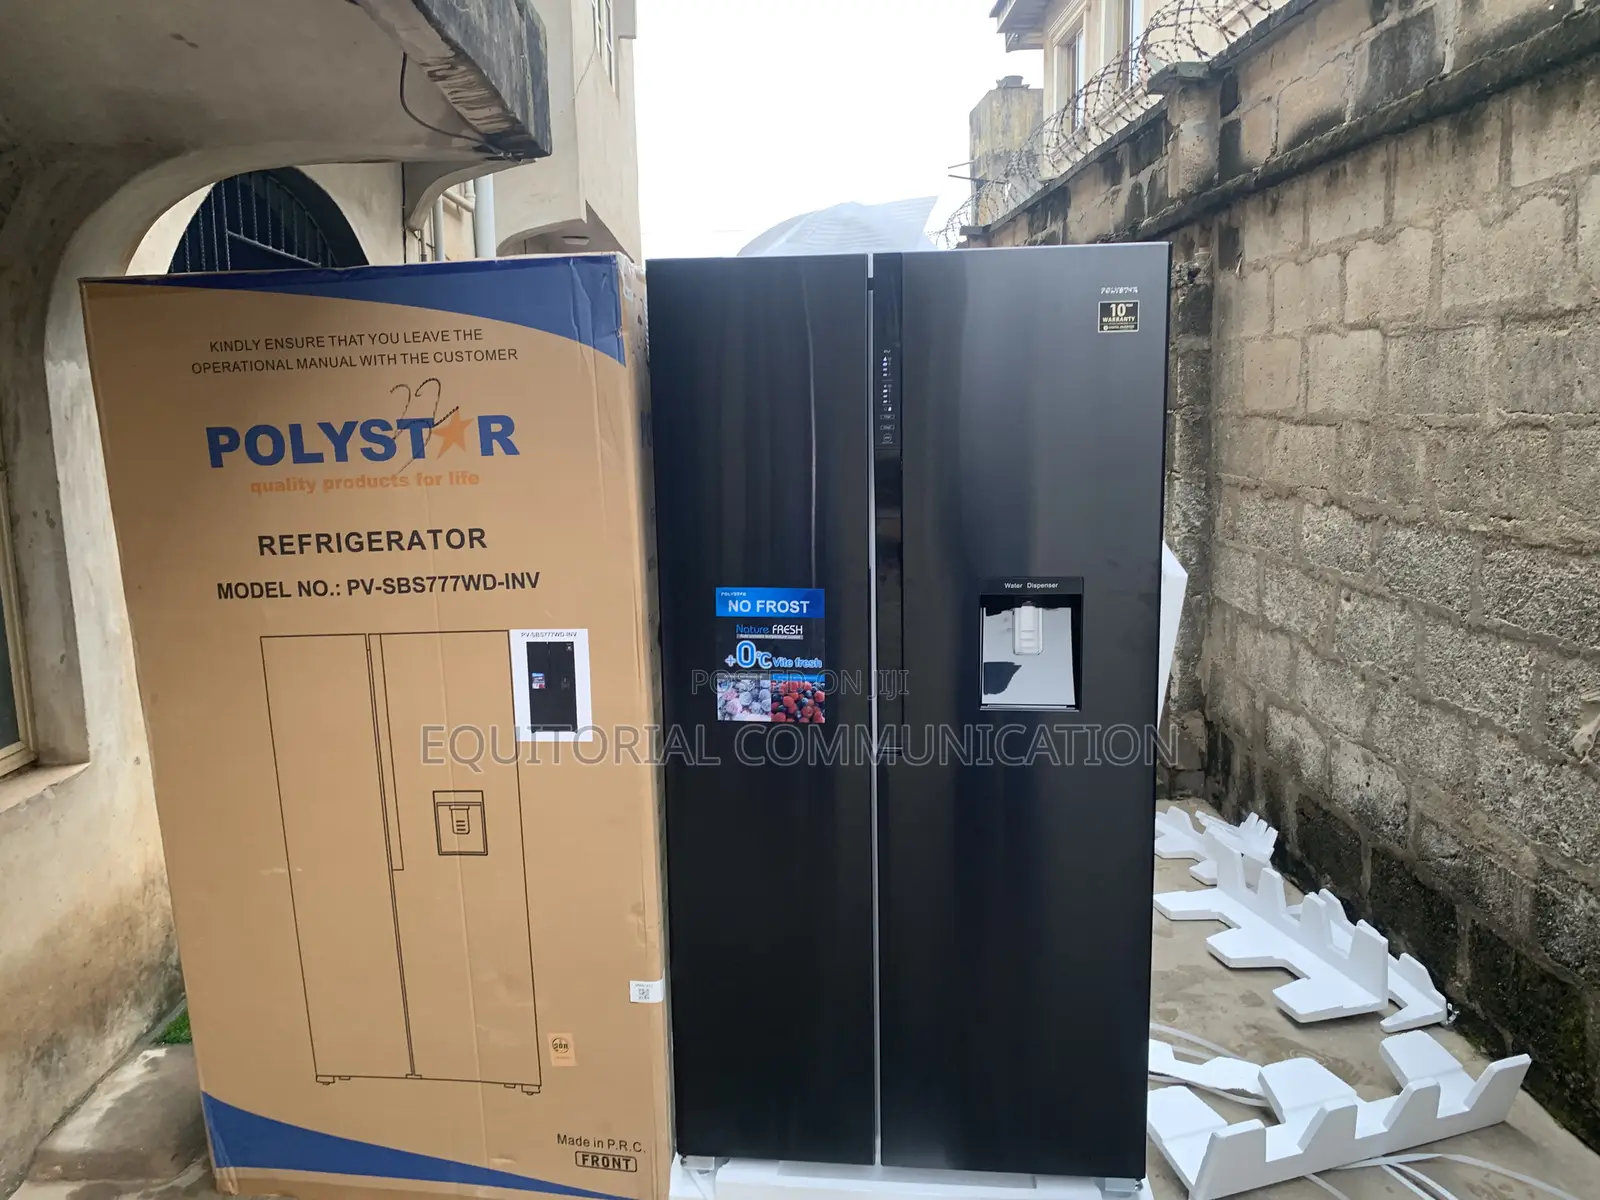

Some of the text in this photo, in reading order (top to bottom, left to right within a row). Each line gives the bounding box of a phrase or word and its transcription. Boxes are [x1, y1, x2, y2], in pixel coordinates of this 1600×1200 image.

[1110, 303, 1126, 317] 10
[209, 328, 483, 353] KINDLY ENSURE THAT YOU LEAVE THE
[191, 348, 518, 375] OPERATIONAL MANUAL WITH THE CUSTOMER
[250, 470, 480, 496] quality products for life
[257, 527, 488, 556] REFRIGERATOR
[217, 571, 541, 600] MODEL NO.: PV-SBS777WD-INV
[728, 599, 810, 614] NO FROST
[736, 624, 803, 635] Nature FRESH
[773, 657, 793, 668] Vite
[794, 656, 822, 668] fresh
[557, 1133, 646, 1153] Made in P.R.C.
[581, 1153, 631, 1170] FRONT
